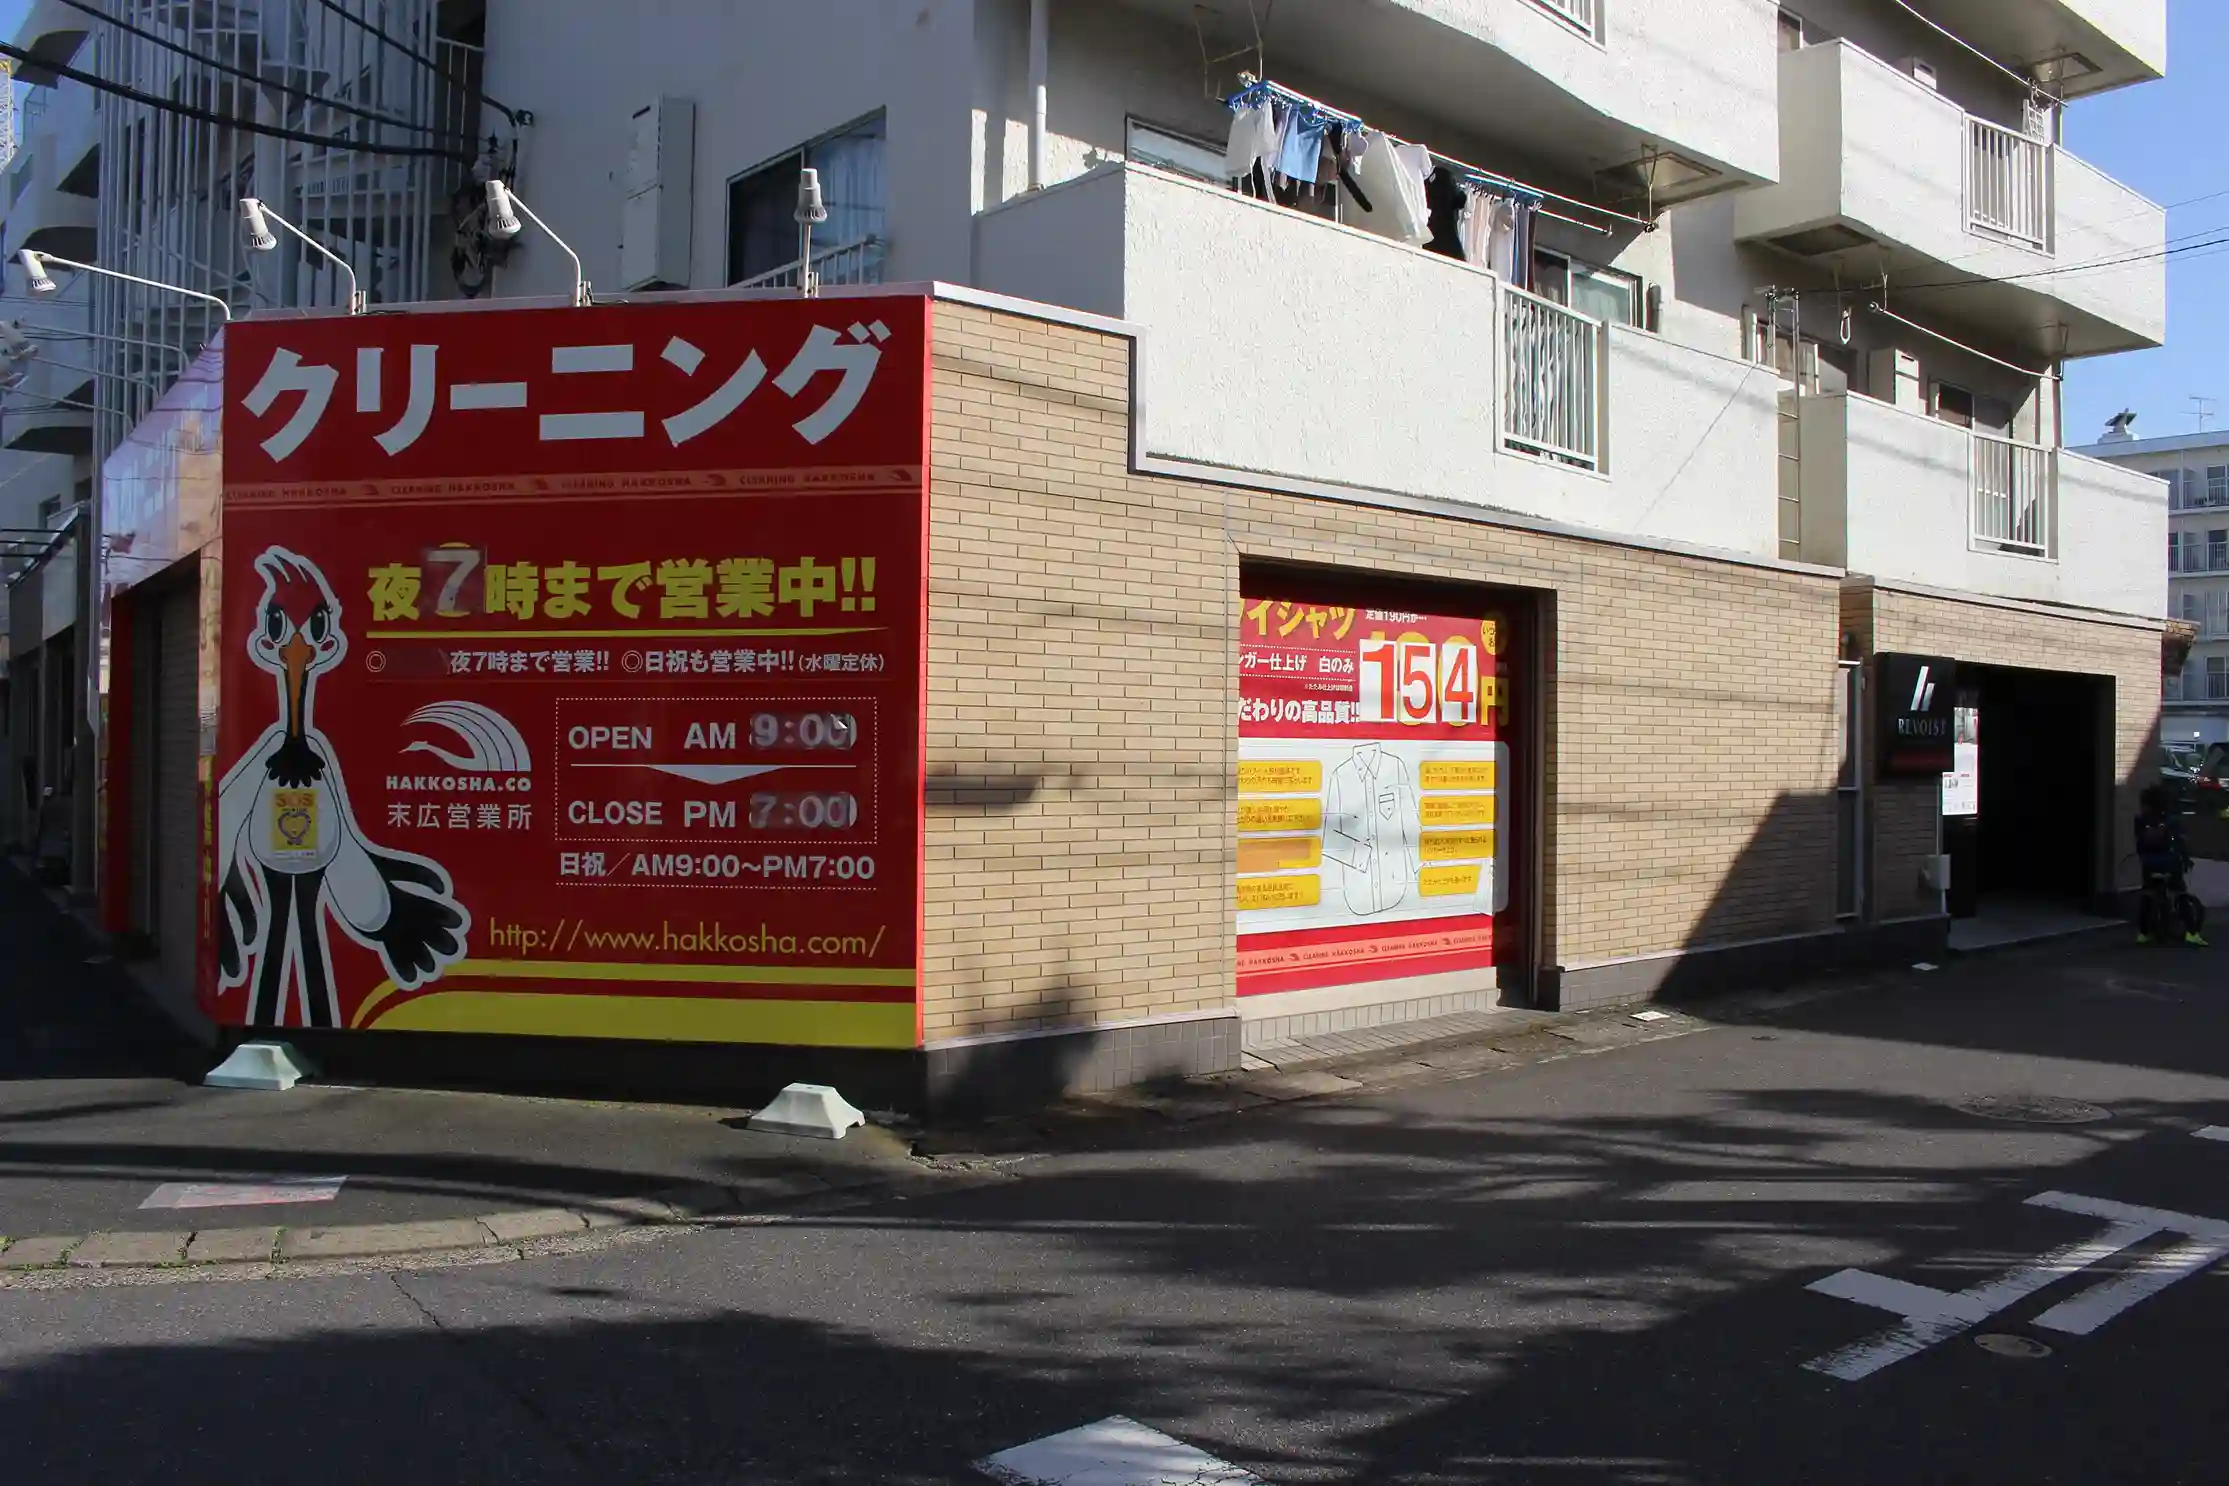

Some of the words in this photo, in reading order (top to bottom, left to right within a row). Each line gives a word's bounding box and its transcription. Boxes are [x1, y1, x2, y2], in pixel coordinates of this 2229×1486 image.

[241, 319, 892, 463] クリーニング
[1239, 598, 1357, 641] イシャツ
[1239, 651, 1308, 672] ガー仕上げ
[1318, 655, 1354, 674] 白のみ
[568, 726, 653, 750] OPEN
[683, 722, 737, 750] AM
[753, 713, 848, 748] 9:00
[386, 775, 532, 792] HAKKOSHA.CO
[387, 802, 533, 831] 末広営業所
[568, 800, 663, 825] CLOSE
[683, 801, 737, 828] PM
[751, 794, 850, 829] 7:00
[489, 917, 887, 958] http://www.hakkosha.com/
